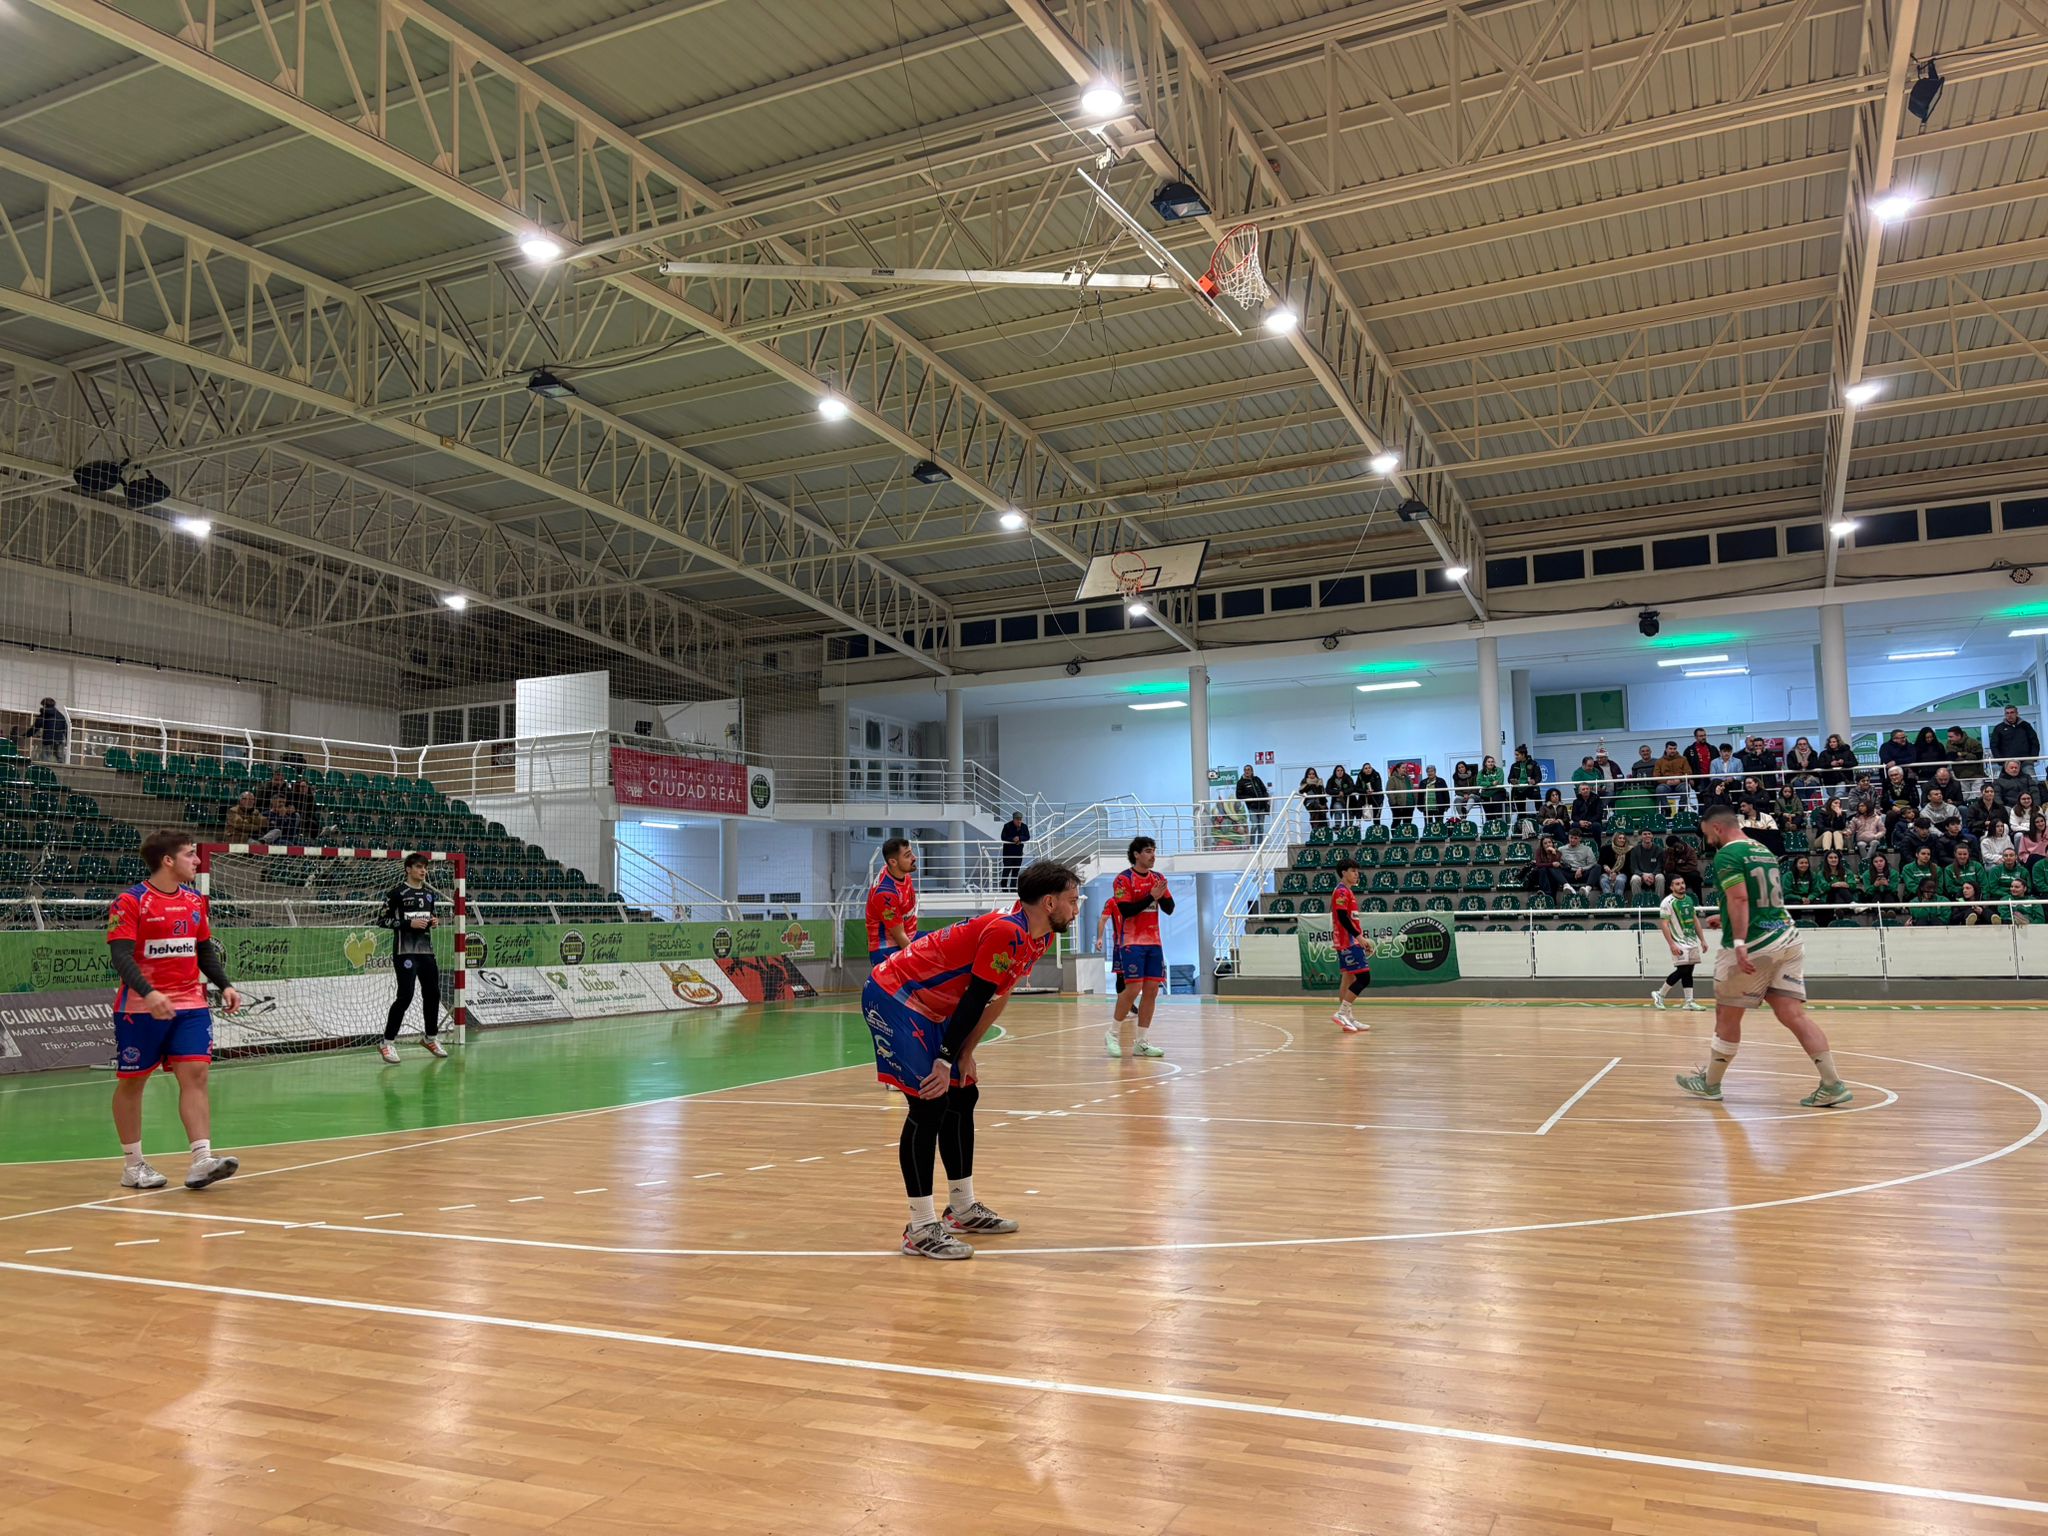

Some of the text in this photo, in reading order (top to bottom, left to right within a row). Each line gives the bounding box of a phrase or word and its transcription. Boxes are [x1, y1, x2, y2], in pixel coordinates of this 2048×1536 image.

[730, 776, 743, 786] DE
[648, 779, 706, 800] CIUDAD
[710, 786, 743, 803] REAL
[1750, 866, 1784, 908] 18
[418, 898, 425, 908] 3
[173, 920, 188, 936] 21
[1373, 927, 1393, 938] L@S
[1406, 933, 1443, 952] CBMB
[148, 943, 195, 955] helvetia
[1415, 952, 1434, 960] CLUB
[578, 966, 600, 977] Bar
[508, 989, 535, 997] Dental
[478, 997, 504, 1005] ANTONIO
[529, 994, 555, 1002] NAVARRO
[1, 1005, 66, 1025] CLINICA
